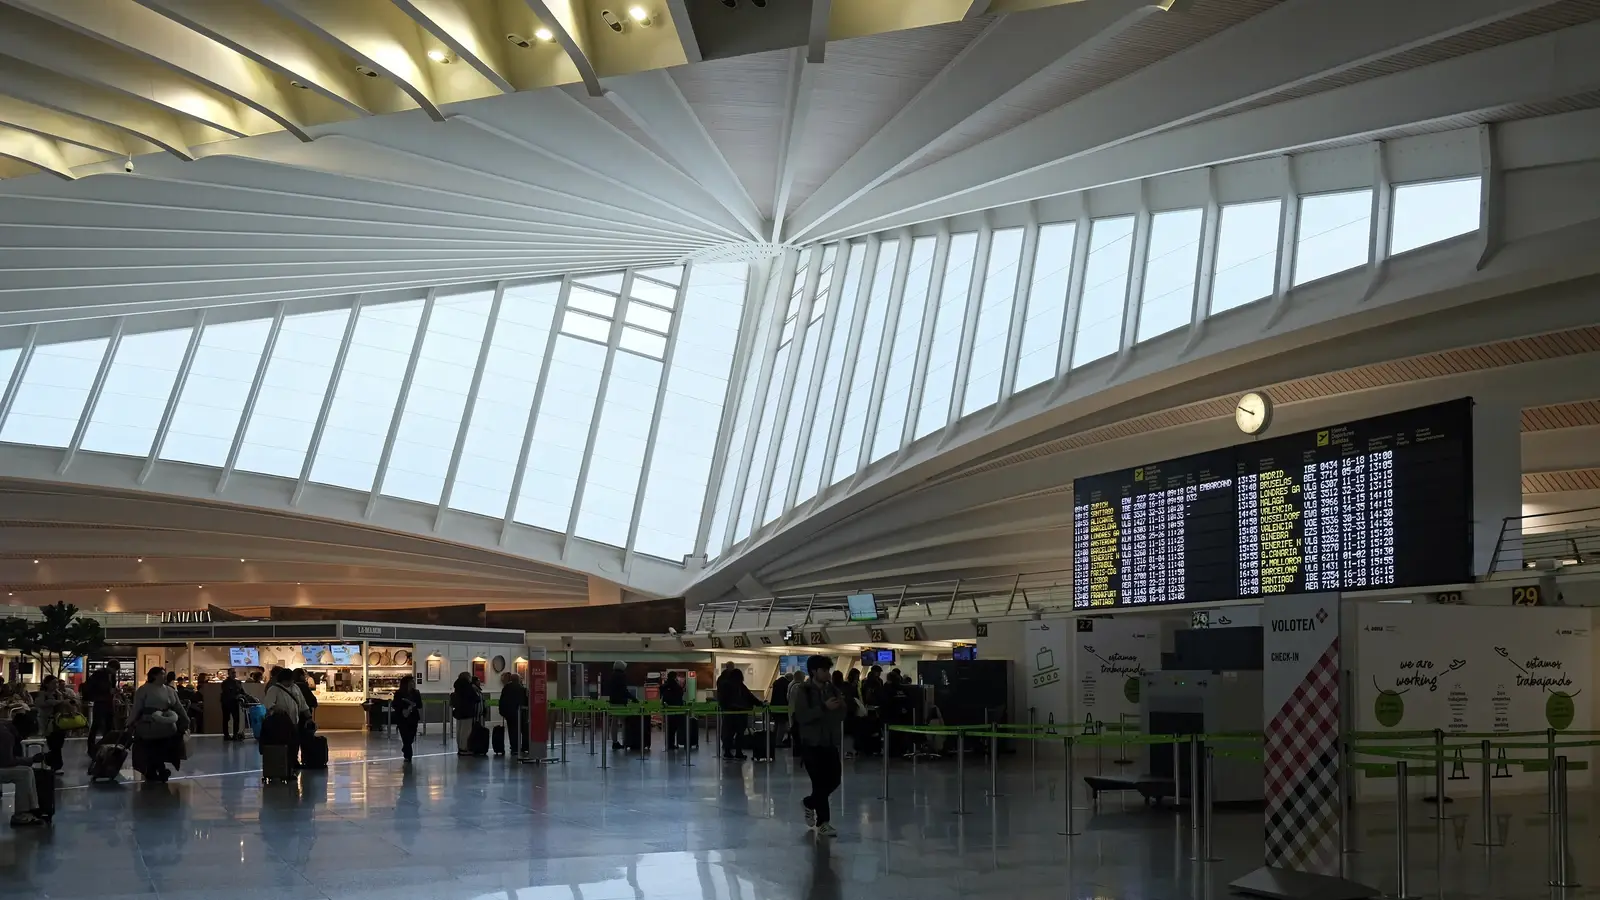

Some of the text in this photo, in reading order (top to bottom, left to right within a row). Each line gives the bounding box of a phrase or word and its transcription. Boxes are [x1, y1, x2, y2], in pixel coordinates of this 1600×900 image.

[1238, 474, 1256, 485] 13:35
[1320, 460, 1338, 471] 0434
[1342, 455, 1364, 467] 16-18
[1370, 450, 1392, 462] 13:00
[1238, 483, 1257, 493] 13:40
[1320, 469, 1338, 480] 3714
[1342, 464, 1365, 476] 05-07
[1370, 460, 1392, 472] 13:05
[1238, 491, 1257, 502] 13:50
[1320, 478, 1338, 489] 6307
[1343, 474, 1365, 486] 11-15
[1370, 470, 1393, 481] 13:15
[1238, 500, 1257, 510] 13:50
[1320, 488, 1338, 498] 3512
[1343, 483, 1365, 495] 32-32
[1370, 479, 1393, 491] 13:15
[1239, 509, 1257, 519] 14:45
[1321, 497, 1338, 507] 3966
[1343, 493, 1365, 504] 11-15
[1370, 489, 1393, 500] 14:10
[1239, 517, 1257, 527] 14:50
[1321, 506, 1338, 516] 9519
[1343, 502, 1365, 513] 34-35
[1370, 498, 1393, 510] 14:15
[1239, 526, 1257, 536] 15:05
[1321, 515, 1338, 525] 3536
[1343, 512, 1365, 522] 30-31
[1370, 508, 1393, 519] 14:30
[1239, 534, 1258, 544] 15:20
[1321, 524, 1338, 534] 1362
[1343, 521, 1365, 532] 32-33
[1370, 518, 1393, 528] 14:56
[1239, 543, 1258, 552] 15:55
[1321, 534, 1339, 543] 3262
[1343, 530, 1366, 541] 11-15
[1370, 527, 1393, 538] 15:20
[1240, 552, 1258, 561] 15:55
[1321, 543, 1339, 552] 3270
[1344, 540, 1366, 550] 11-15
[1370, 537, 1394, 547] 15:20
[1240, 560, 1258, 570] 16:05
[1322, 552, 1339, 562] 6211
[1344, 549, 1366, 559] 01-02
[1371, 546, 1394, 557] 15:30
[1240, 569, 1258, 578] 16:30
[1322, 561, 1339, 571] 1431
[1344, 559, 1366, 569] 11-15
[1371, 556, 1394, 566] 15:55
[1240, 578, 1258, 586] 16:40
[1322, 571, 1339, 580] 2354
[1344, 568, 1366, 578] 16-18
[1371, 566, 1394, 576] 16:15
[1240, 586, 1258, 595] 16:50
[1322, 580, 1339, 589] 7154
[1344, 578, 1366, 587] 19-20
[1371, 575, 1394, 585] 16:15
[1514, 588, 1538, 606] 29
[1272, 618, 1315, 632] VOLOTEA
[1108, 652, 1138, 662] estamos
[1271, 652, 1300, 662] CHECK-IN
[1400, 658, 1434, 669] we are
[1526, 656, 1562, 669] estamos
[1396, 671, 1438, 691] working
[1516, 672, 1572, 692] trabajando
